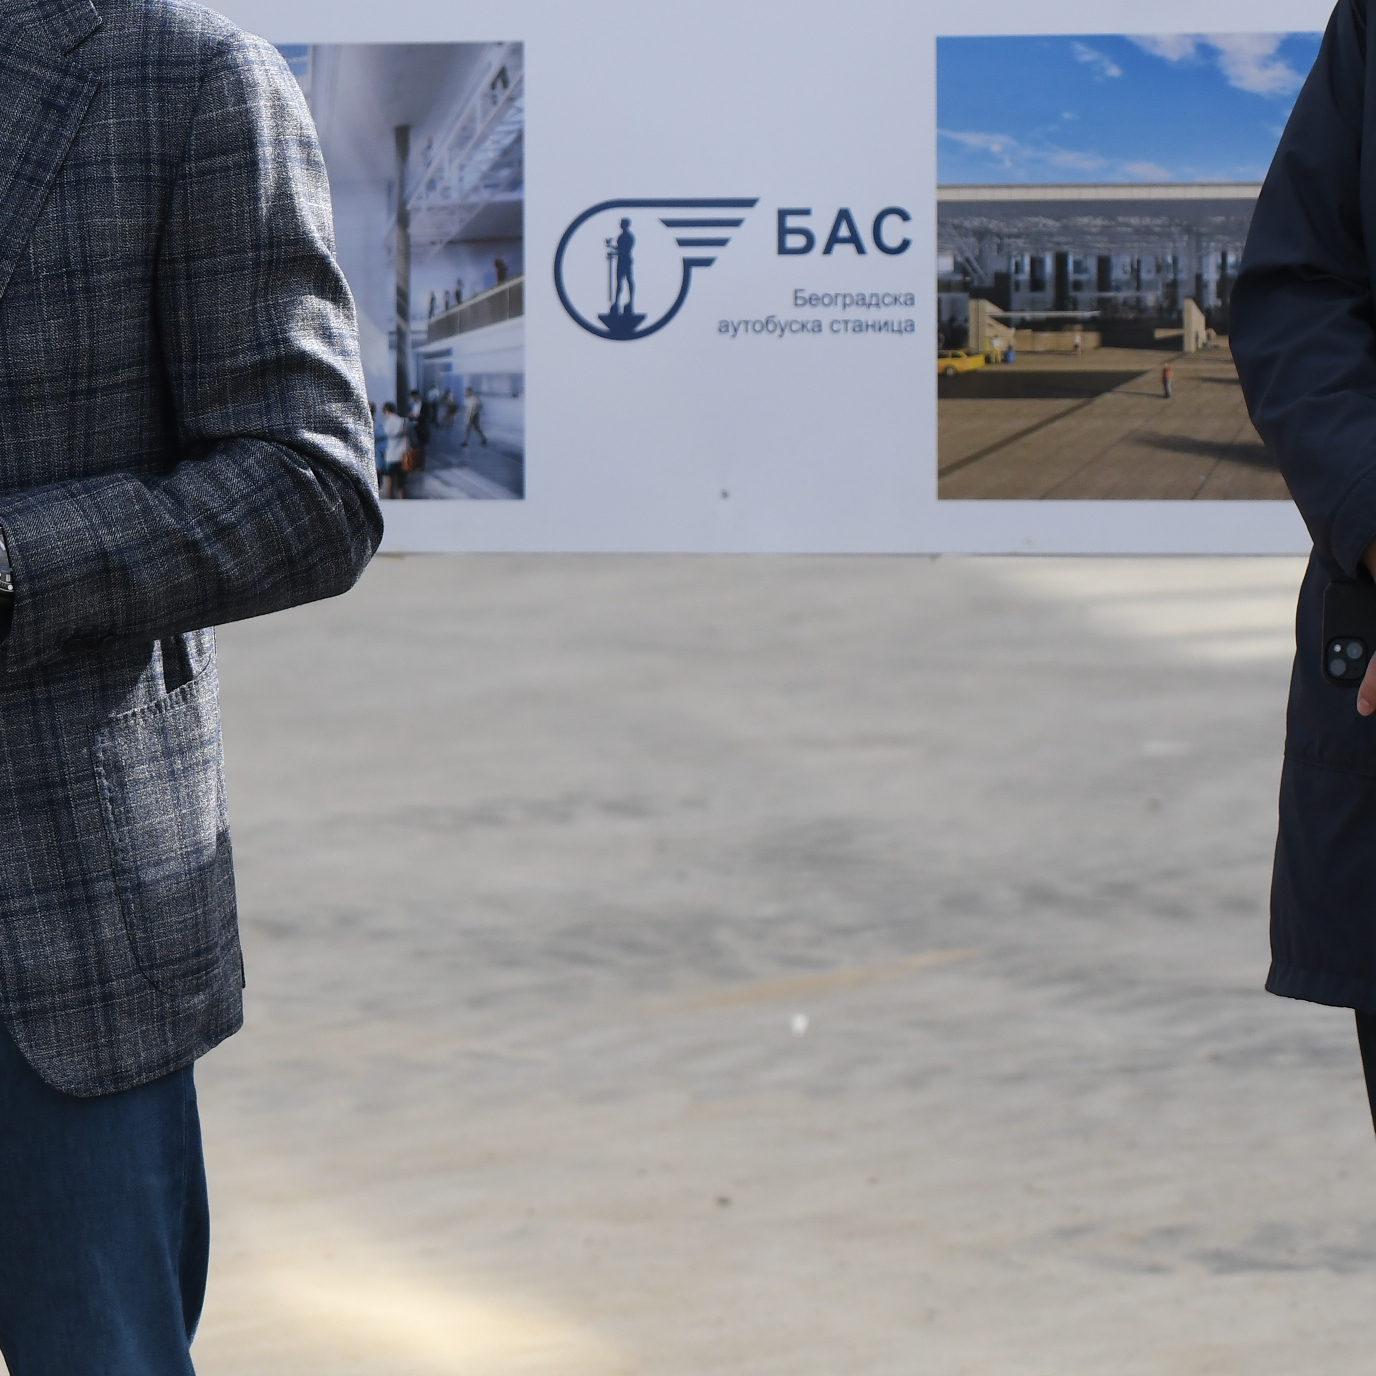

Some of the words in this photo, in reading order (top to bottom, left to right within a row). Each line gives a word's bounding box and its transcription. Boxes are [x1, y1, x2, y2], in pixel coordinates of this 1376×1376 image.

[775, 205, 914, 257] БАС
[792, 288, 916, 311] Београдска
[716, 314, 824, 339] аутобуска
[828, 317, 916, 337] станица
